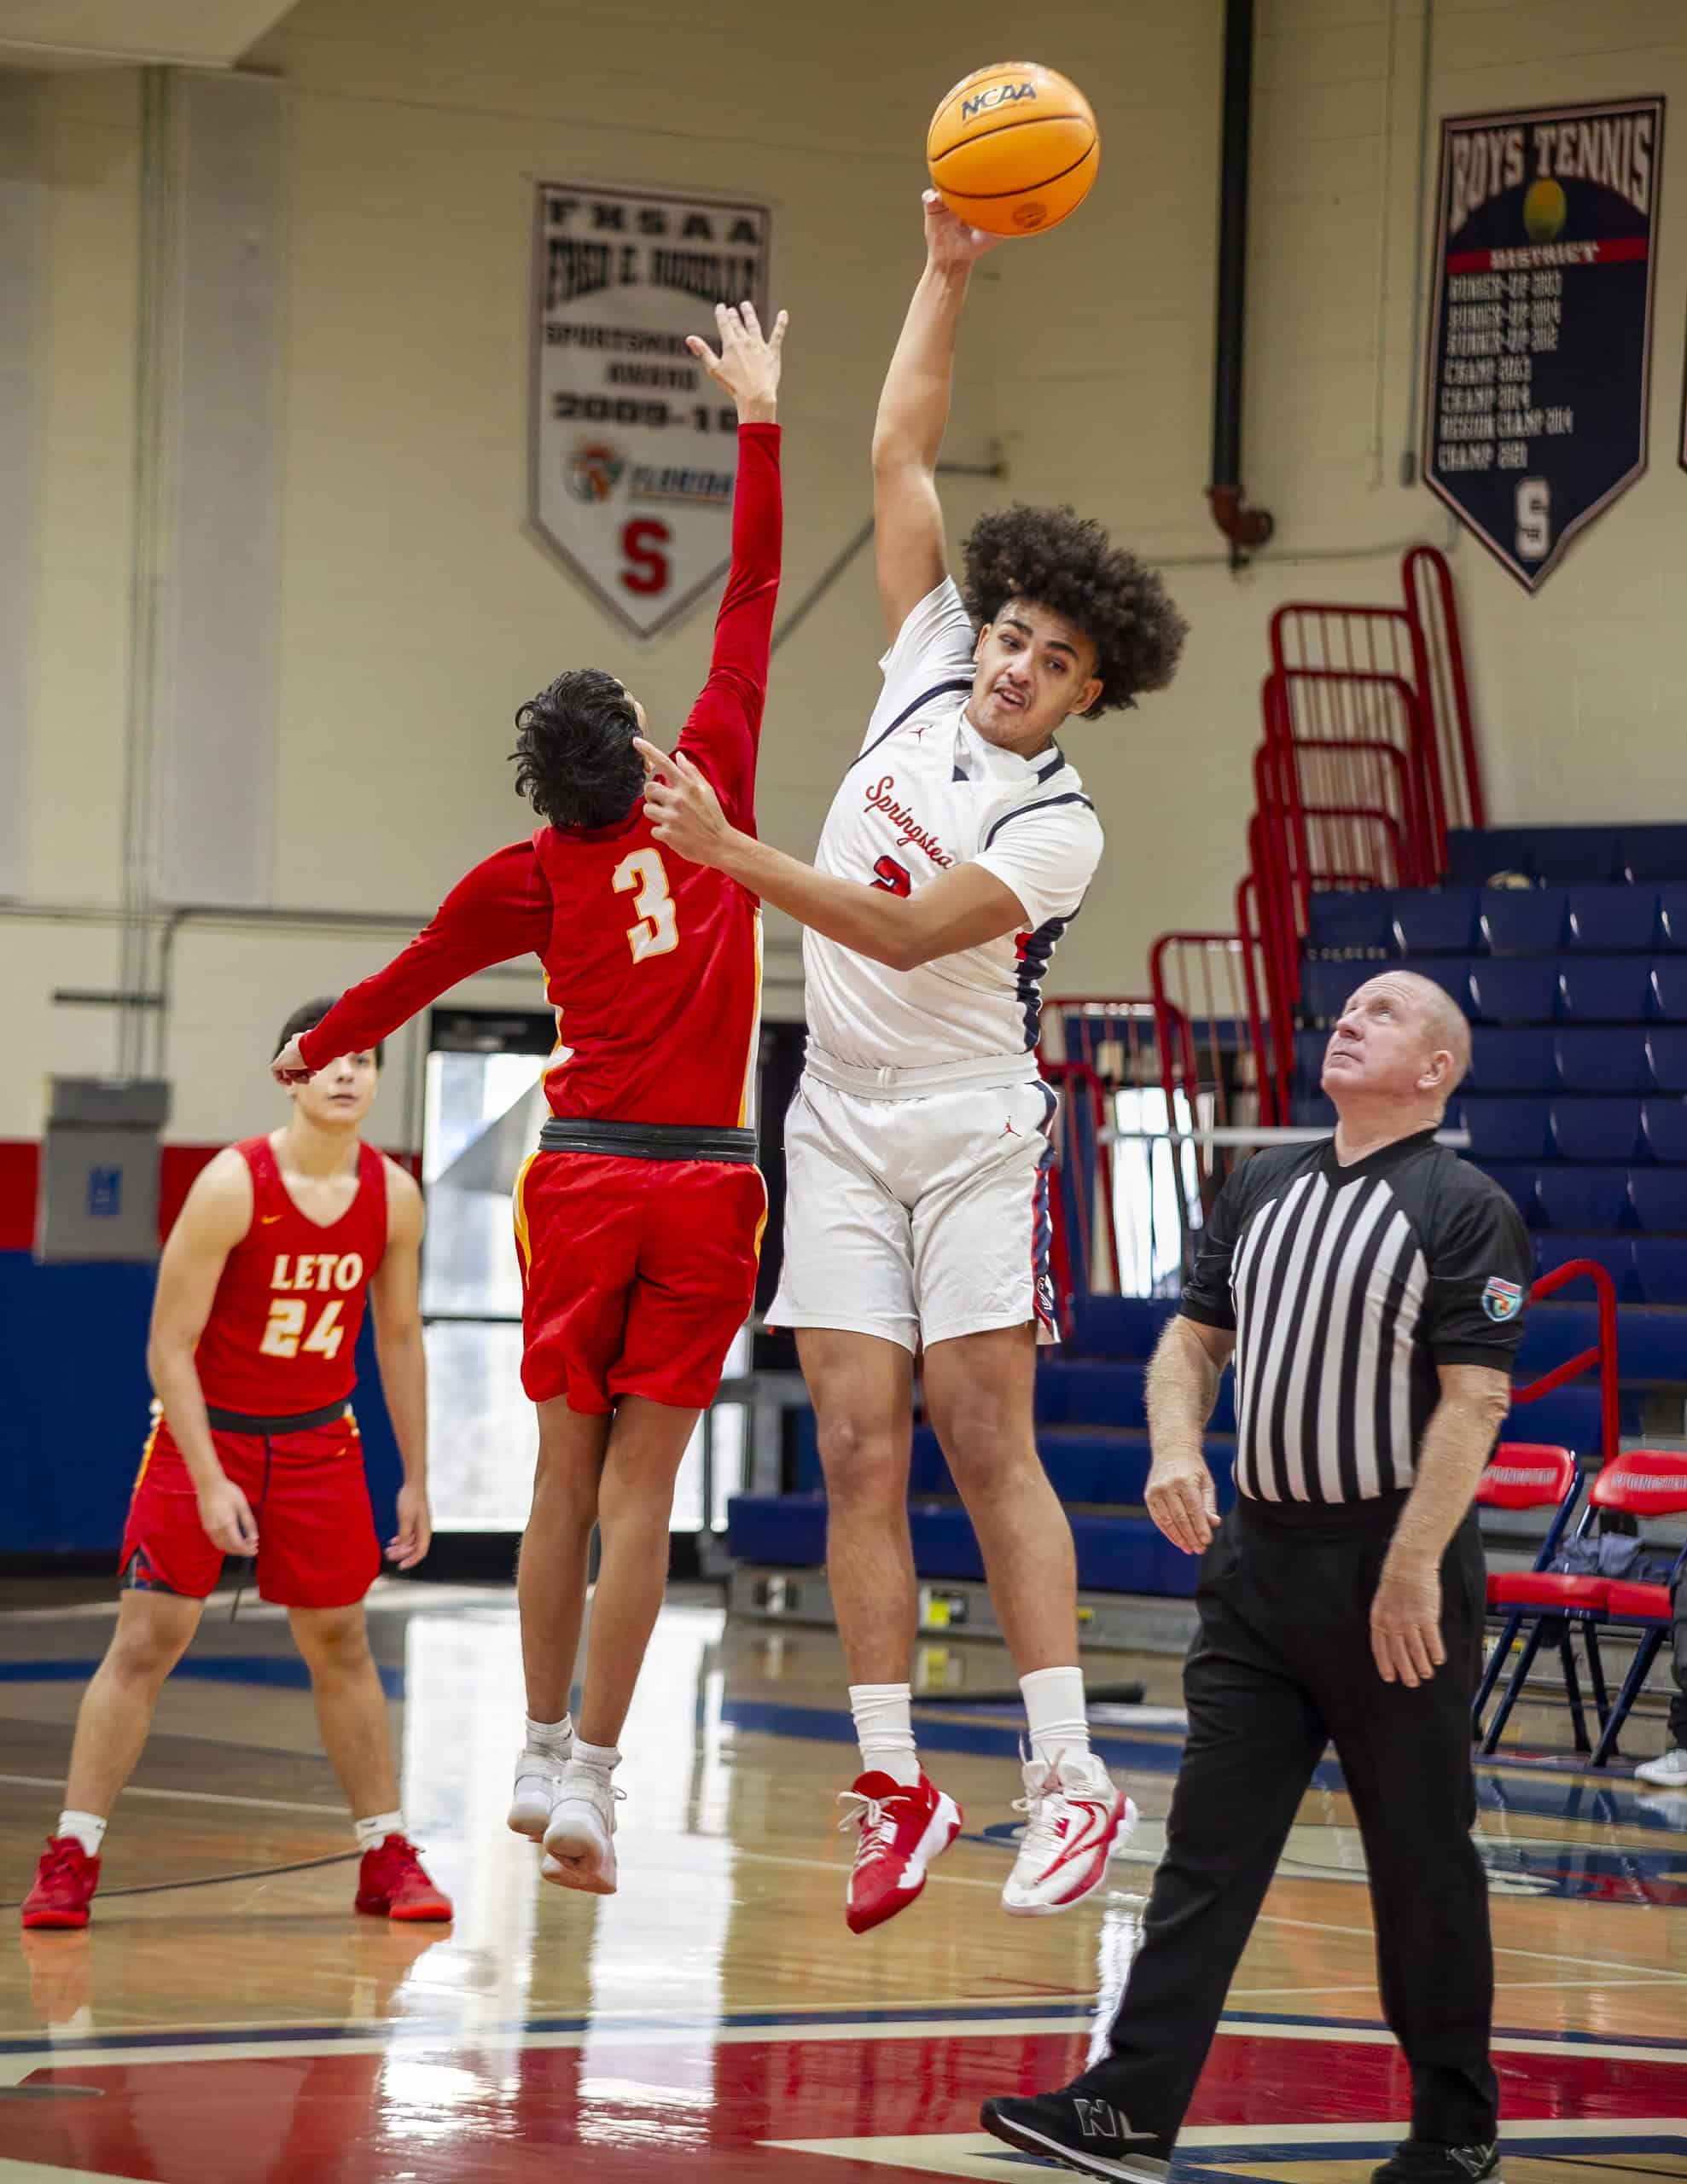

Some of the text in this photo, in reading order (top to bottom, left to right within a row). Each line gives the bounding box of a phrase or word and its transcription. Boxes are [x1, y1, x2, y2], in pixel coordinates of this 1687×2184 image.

[961, 83, 1037, 121] NCAA
[1451, 116, 1651, 234] BOYS TENNIS
[550, 200, 759, 244] FHSAA
[1490, 241, 1599, 270] DISTRICT
[1445, 357, 1495, 384] CHAMP
[1441, 385, 1496, 413] CHAMP
[1497, 409, 1544, 438] CHAMP
[1438, 443, 1492, 472] CHAMP
[1515, 477, 1550, 561] S
[619, 517, 672, 595] S
[864, 775, 955, 870] Springstea
[612, 846, 678, 964] 3
[270, 1252, 364, 1292] LETO
[259, 1298, 345, 1360] 24
